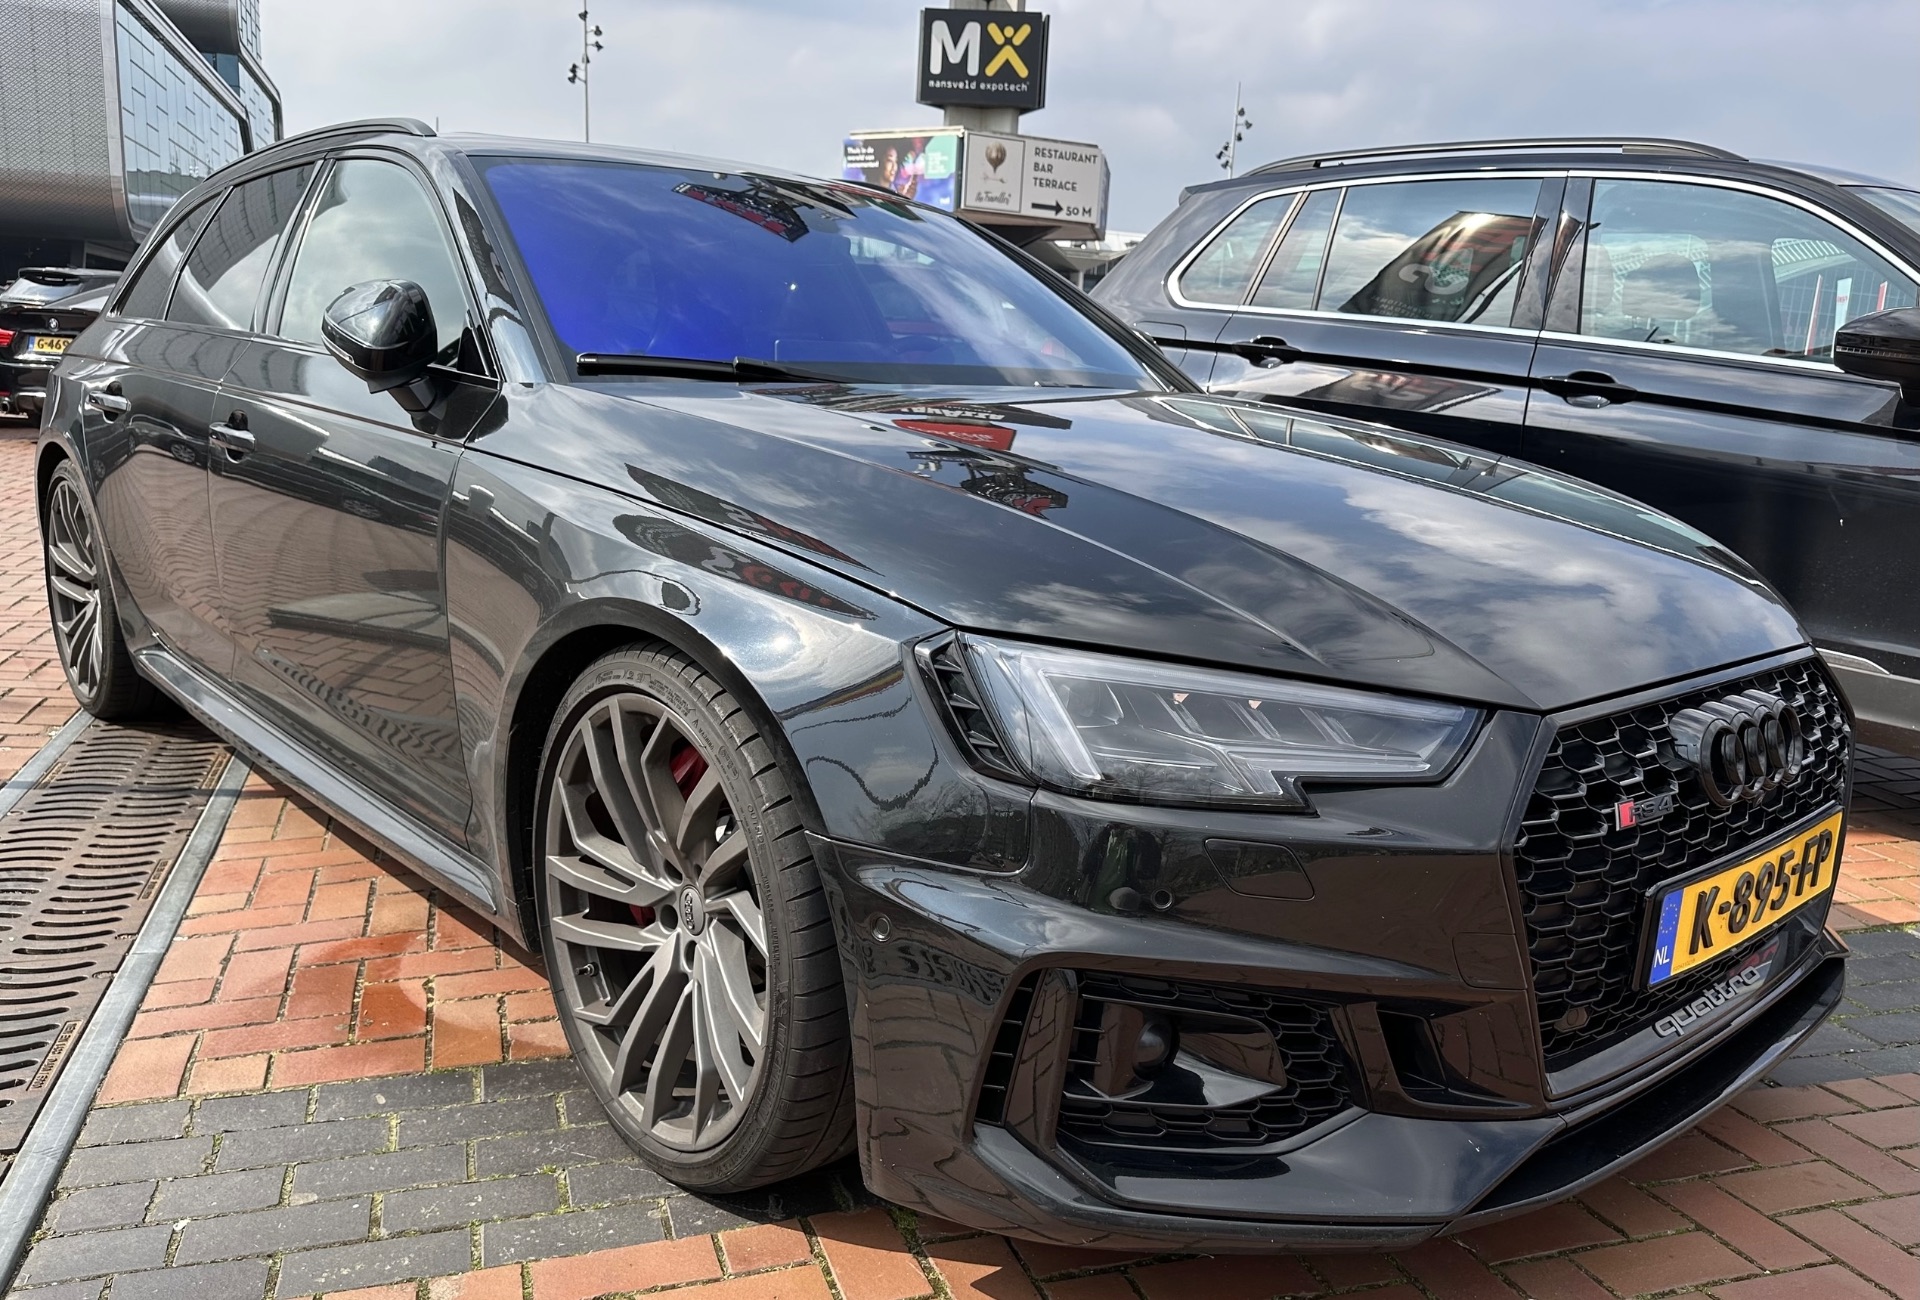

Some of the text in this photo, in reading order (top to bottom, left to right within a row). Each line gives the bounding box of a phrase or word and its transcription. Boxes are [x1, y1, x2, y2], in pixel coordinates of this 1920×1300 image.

[930, 20, 1031, 78] MX
[928, 80, 1028, 92] mansveld expotech
[1034, 147, 1098, 164] RESTAURANT
[1033, 162, 1053, 173] BAR
[1033, 177, 1077, 192] TERRACE
[1066, 206, 1092, 217] 50 M
[1689, 828, 1833, 956] K-895-FP
[1653, 945, 1670, 968] NL
[1653, 965, 1761, 1037] quattro
